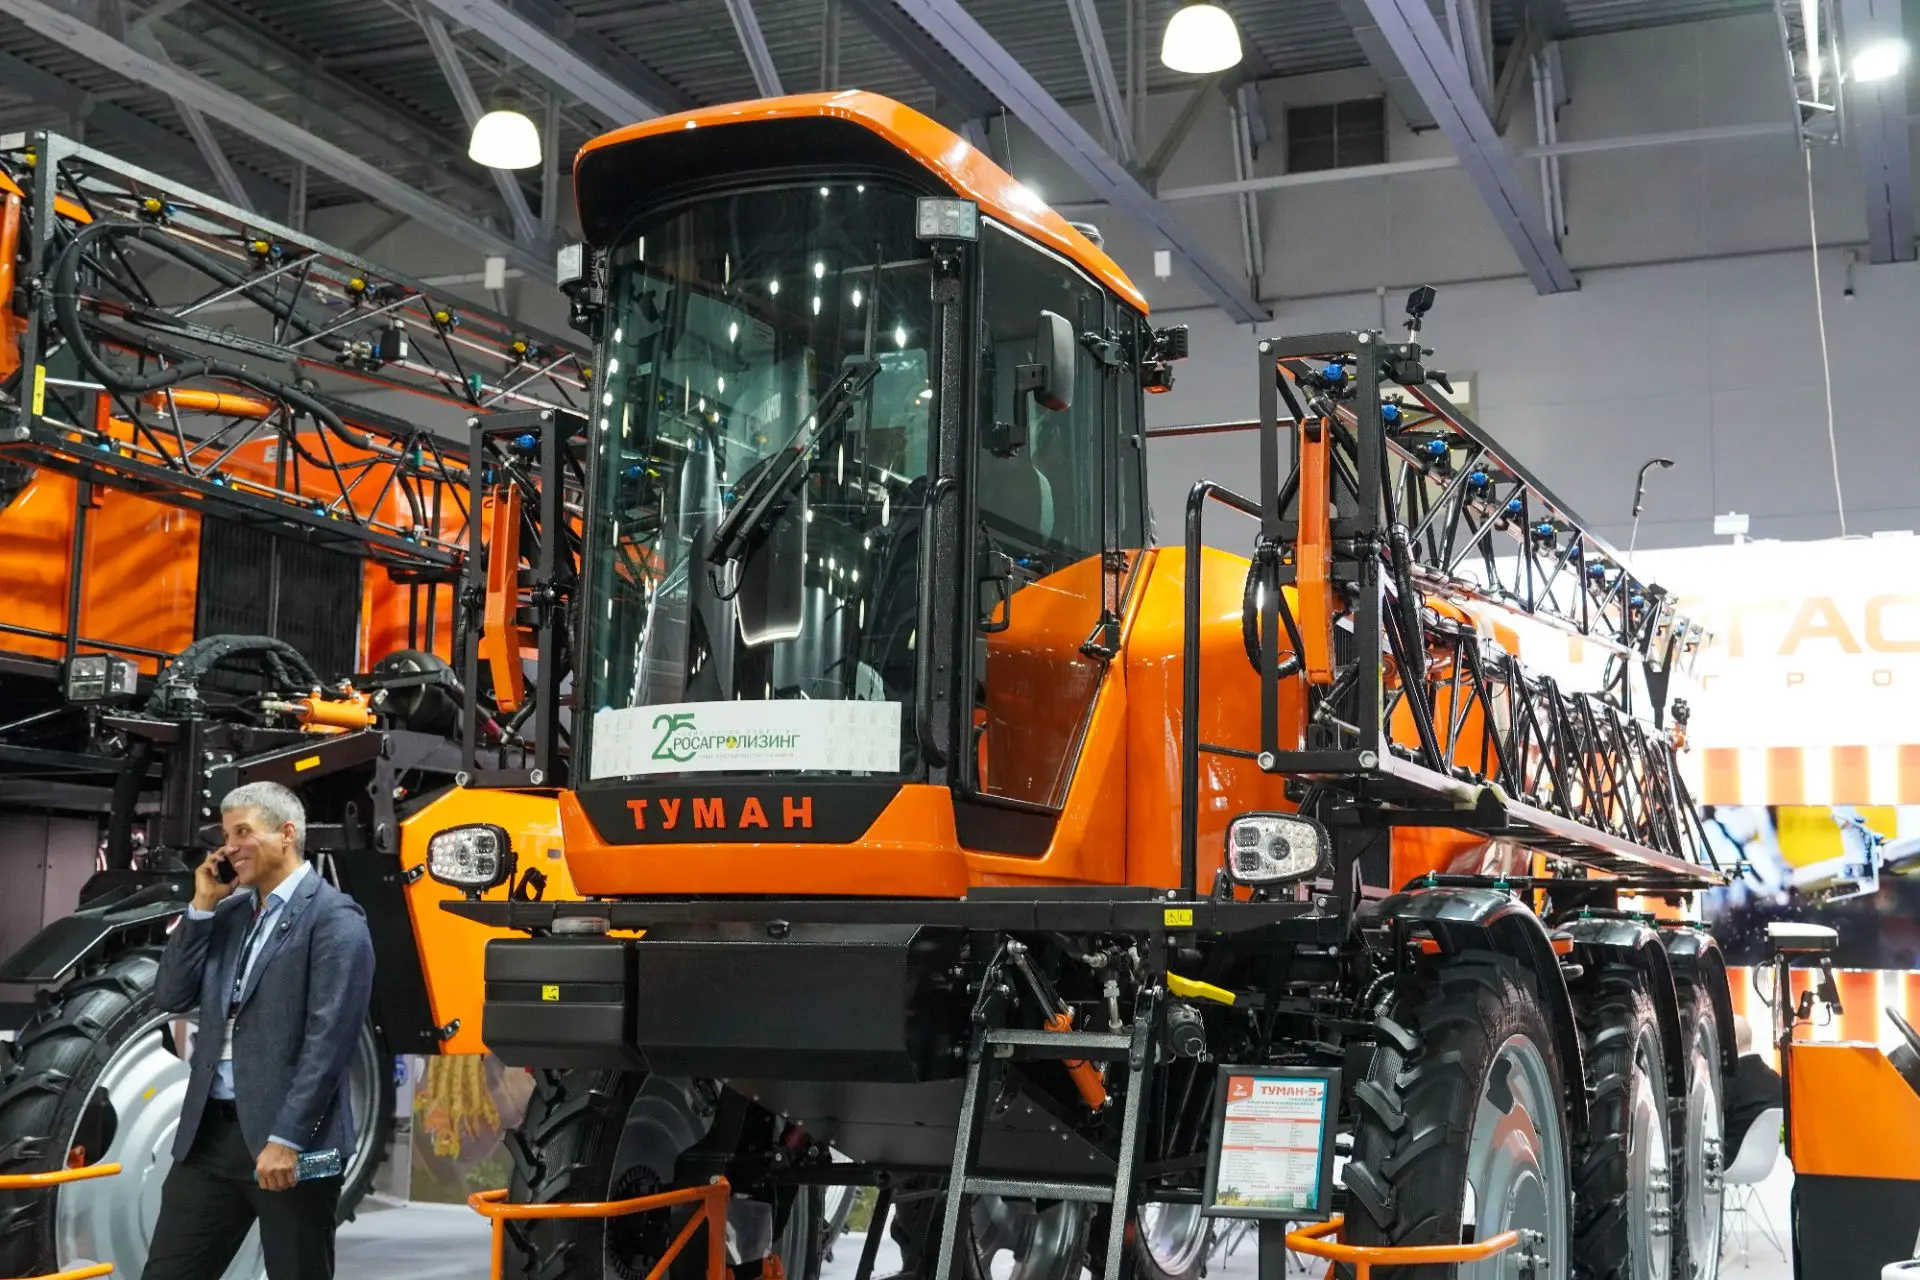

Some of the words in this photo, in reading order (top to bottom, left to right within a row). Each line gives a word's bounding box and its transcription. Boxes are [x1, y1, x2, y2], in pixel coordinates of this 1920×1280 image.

[651, 712, 697, 763] 25
[673, 734, 801, 751] РОСАГРОЛИЗИНГ
[626, 796, 813, 829] ТУМАН
[1260, 1085, 1317, 1097] ТУМАН-5
